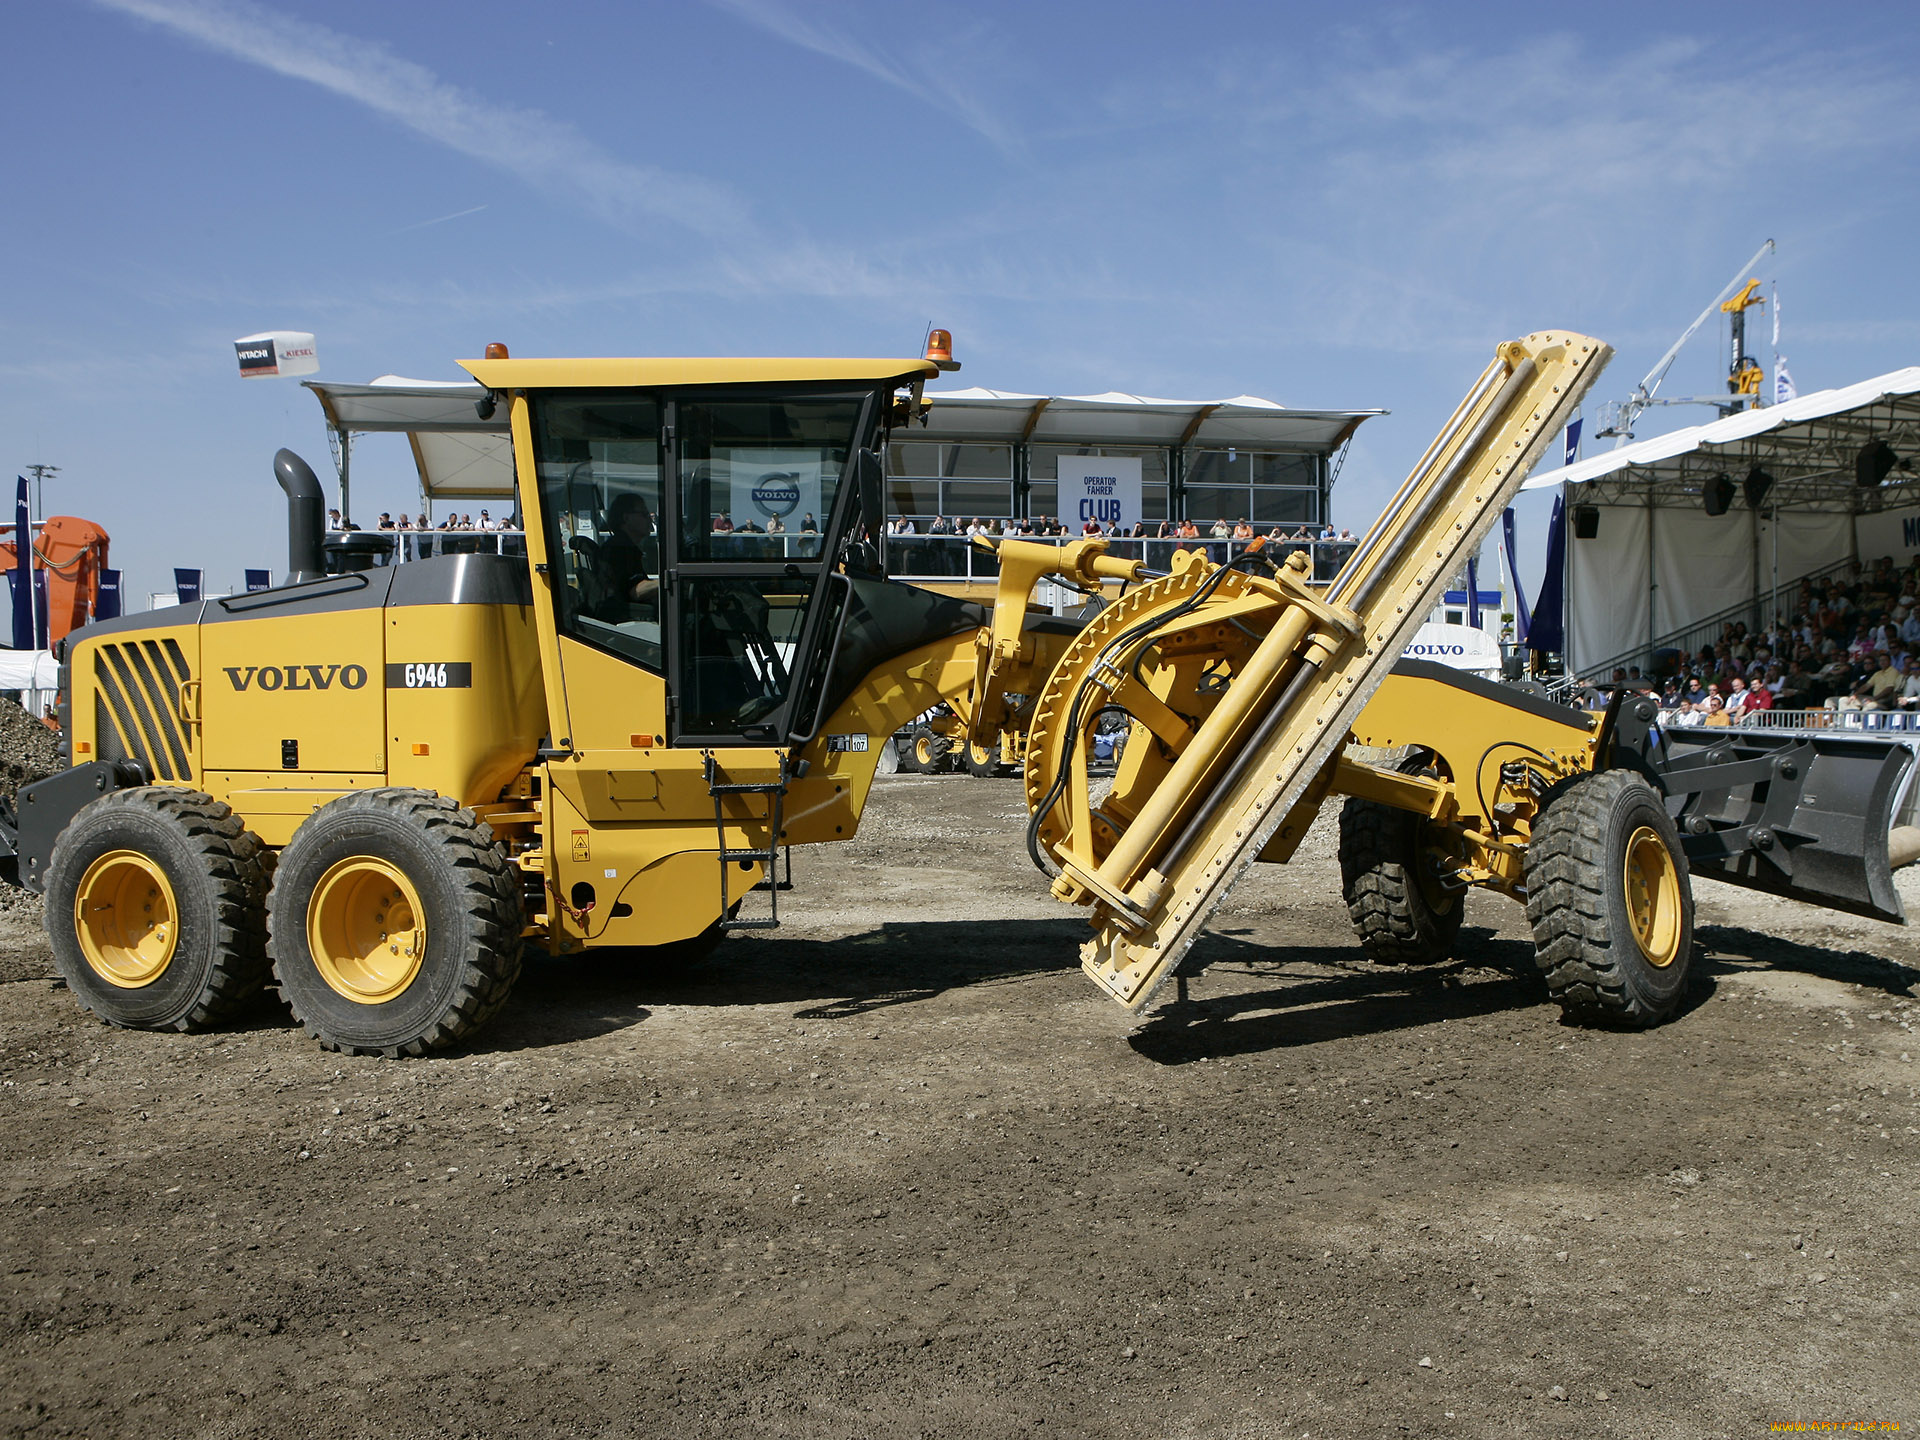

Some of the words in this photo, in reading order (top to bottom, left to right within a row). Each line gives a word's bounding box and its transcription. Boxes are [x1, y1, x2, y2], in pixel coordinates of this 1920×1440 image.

[238, 349, 269, 360] HITACHI
[286, 349, 313, 357] KIESEL
[1083, 476, 1117, 486] OPERATOR
[755, 491, 797, 499] VOLVO
[1087, 485, 1113, 495] FAHRER
[1079, 498, 1121, 523] CLUB
[222, 664, 368, 691] VOLVO
[405, 663, 447, 688] G946
[853, 741, 865, 751] 107
